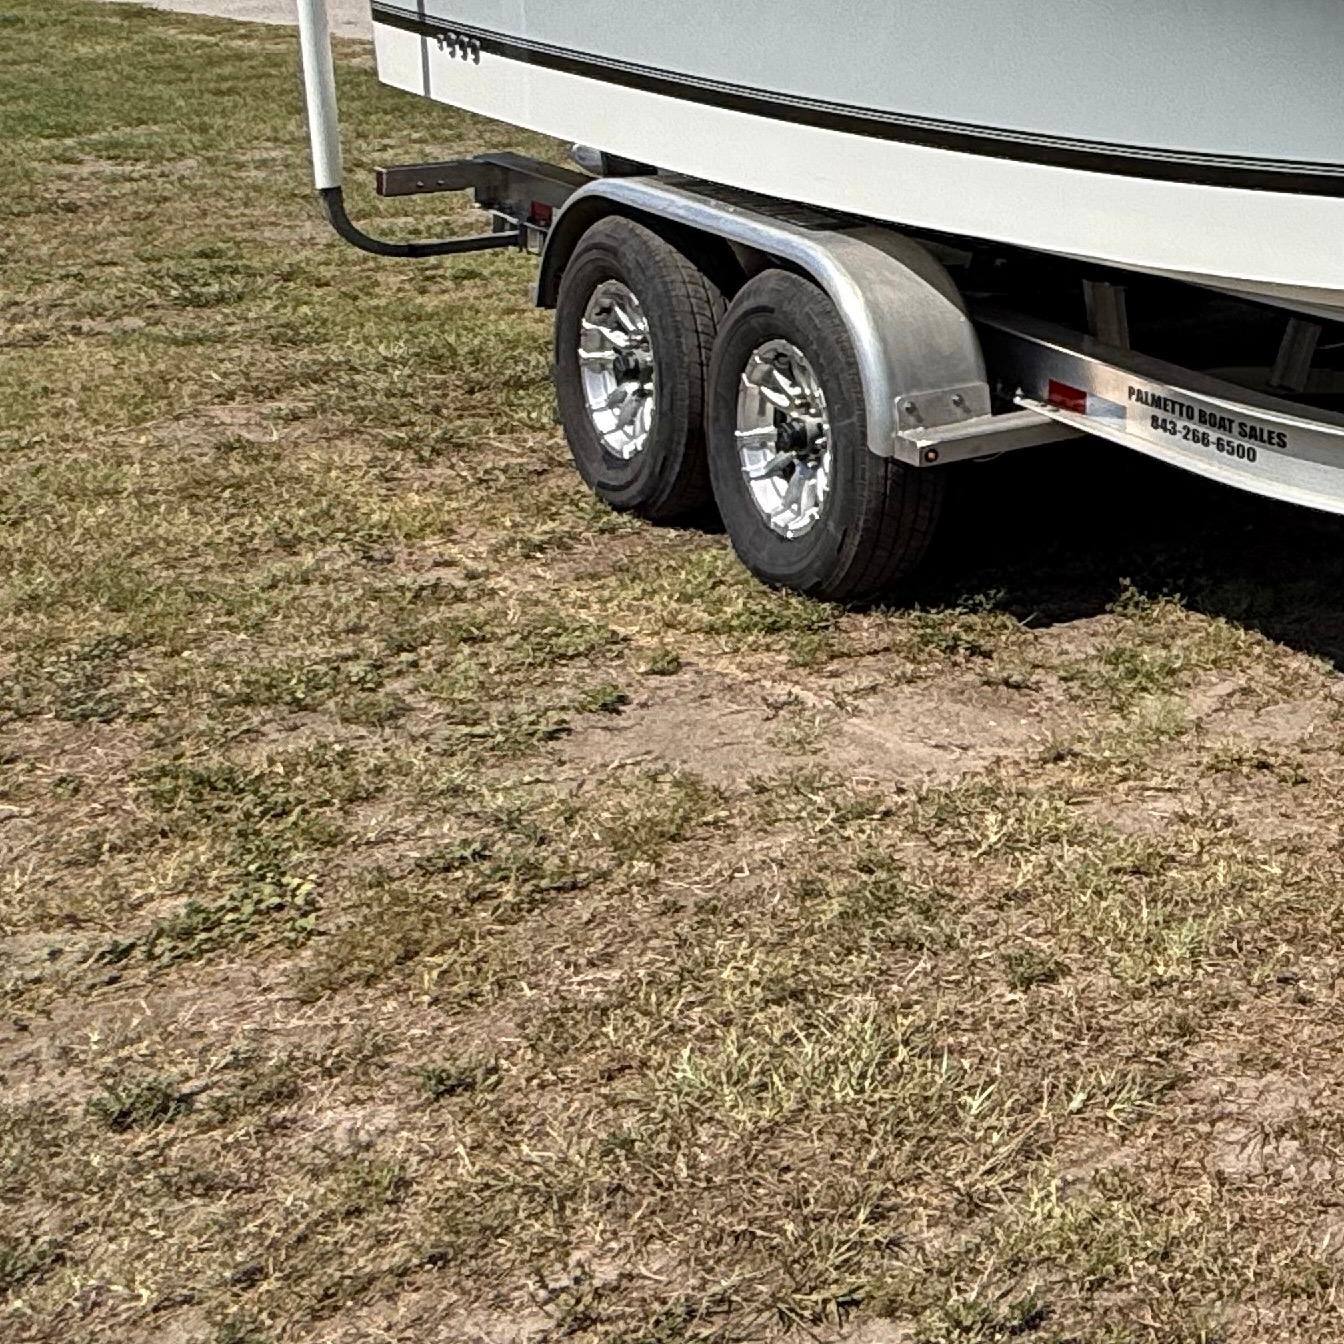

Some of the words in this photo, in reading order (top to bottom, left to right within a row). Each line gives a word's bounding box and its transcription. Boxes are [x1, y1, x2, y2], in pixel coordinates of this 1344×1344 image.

[1128, 386, 1195, 422] PALMETTO
[1198, 408, 1235, 434] BOAT
[1238, 422, 1288, 449] SALES
